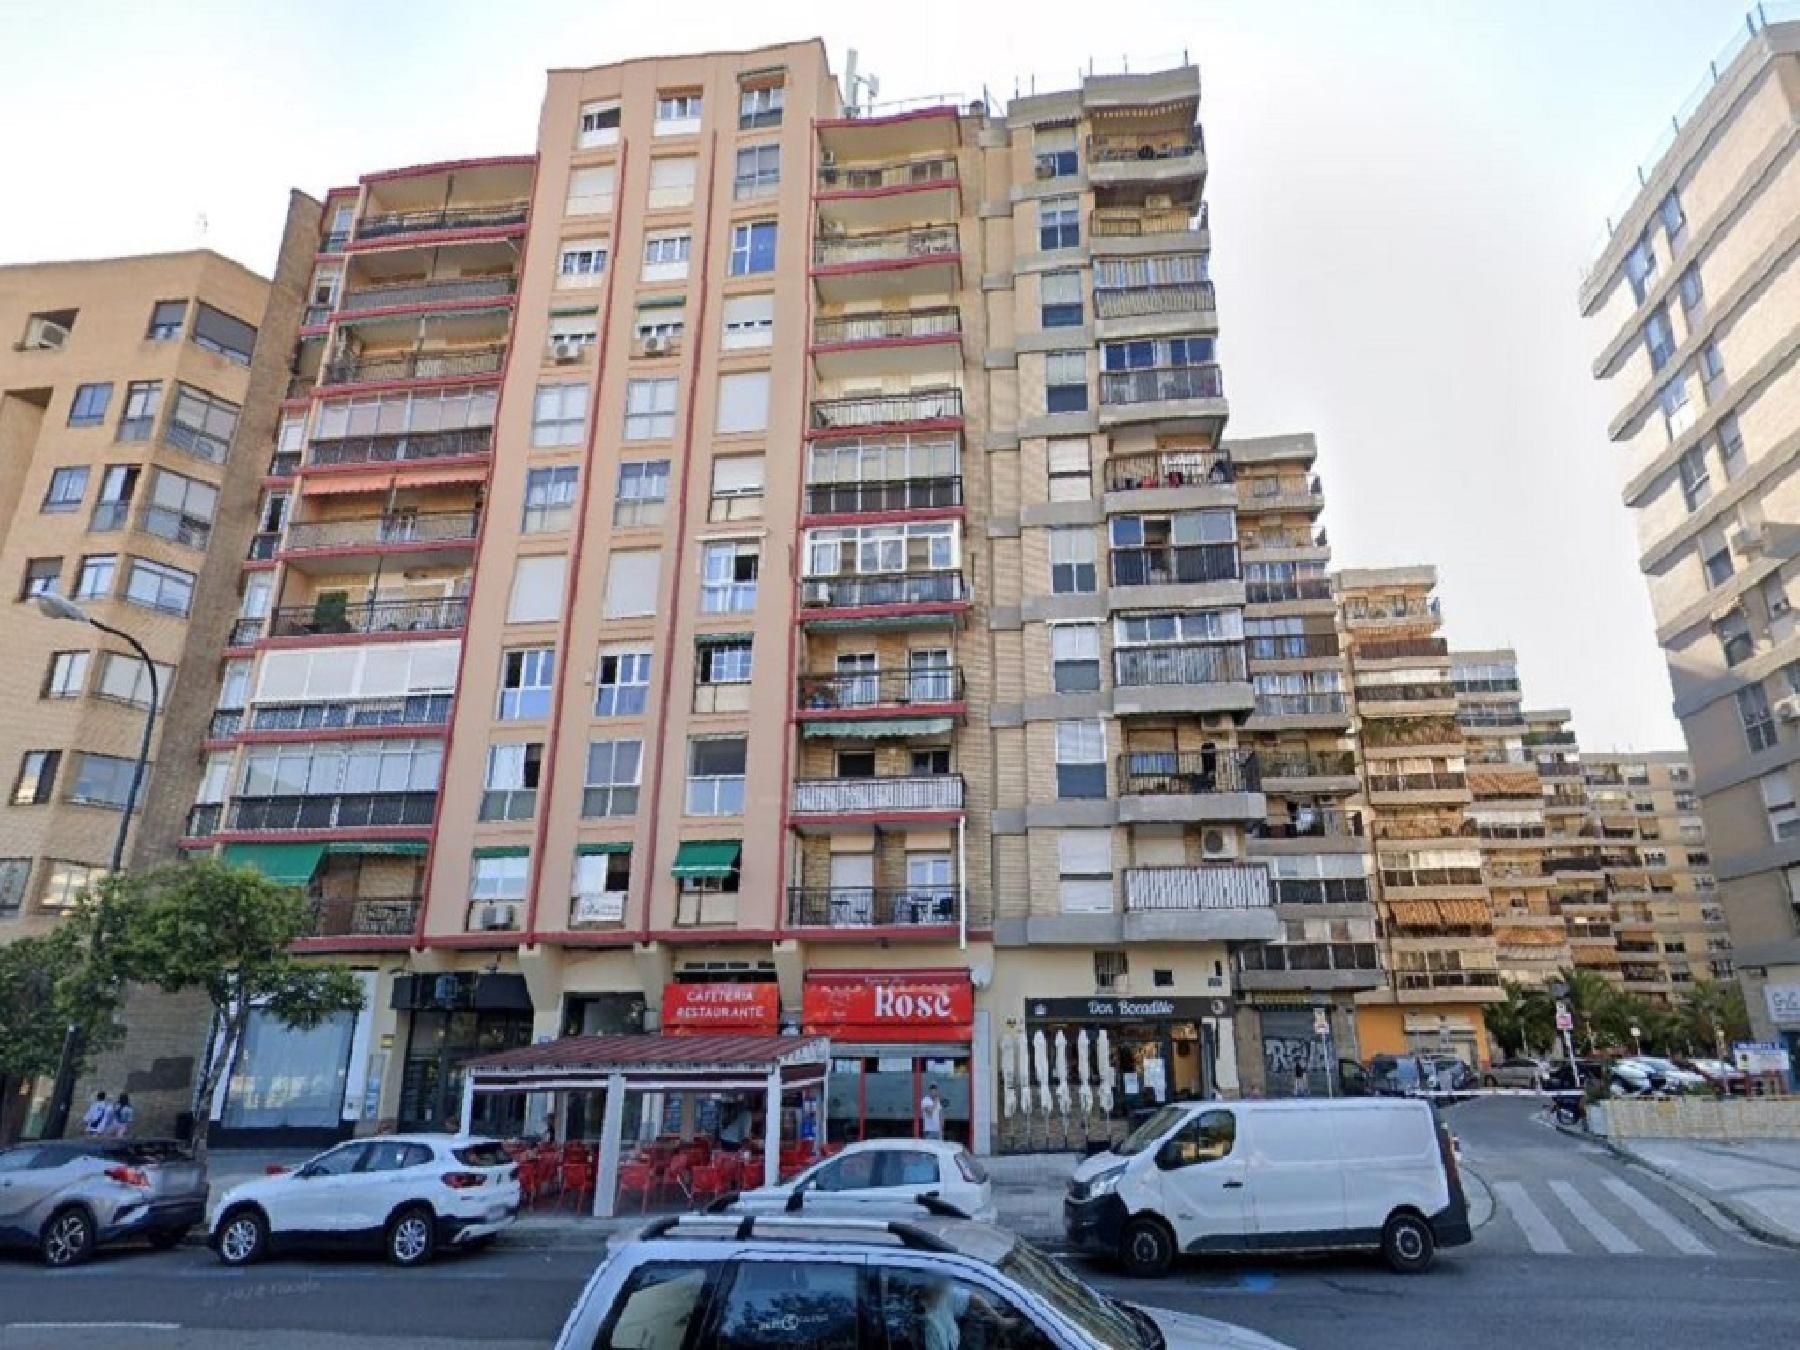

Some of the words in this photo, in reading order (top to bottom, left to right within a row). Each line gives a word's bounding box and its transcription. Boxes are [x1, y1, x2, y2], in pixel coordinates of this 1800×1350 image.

[686, 991, 753, 1003] CAFETERIA
[874, 984, 952, 1017] Rose
[676, 1006, 765, 1018] RESTAURANTE
[1088, 1000, 1113, 1014] Don
